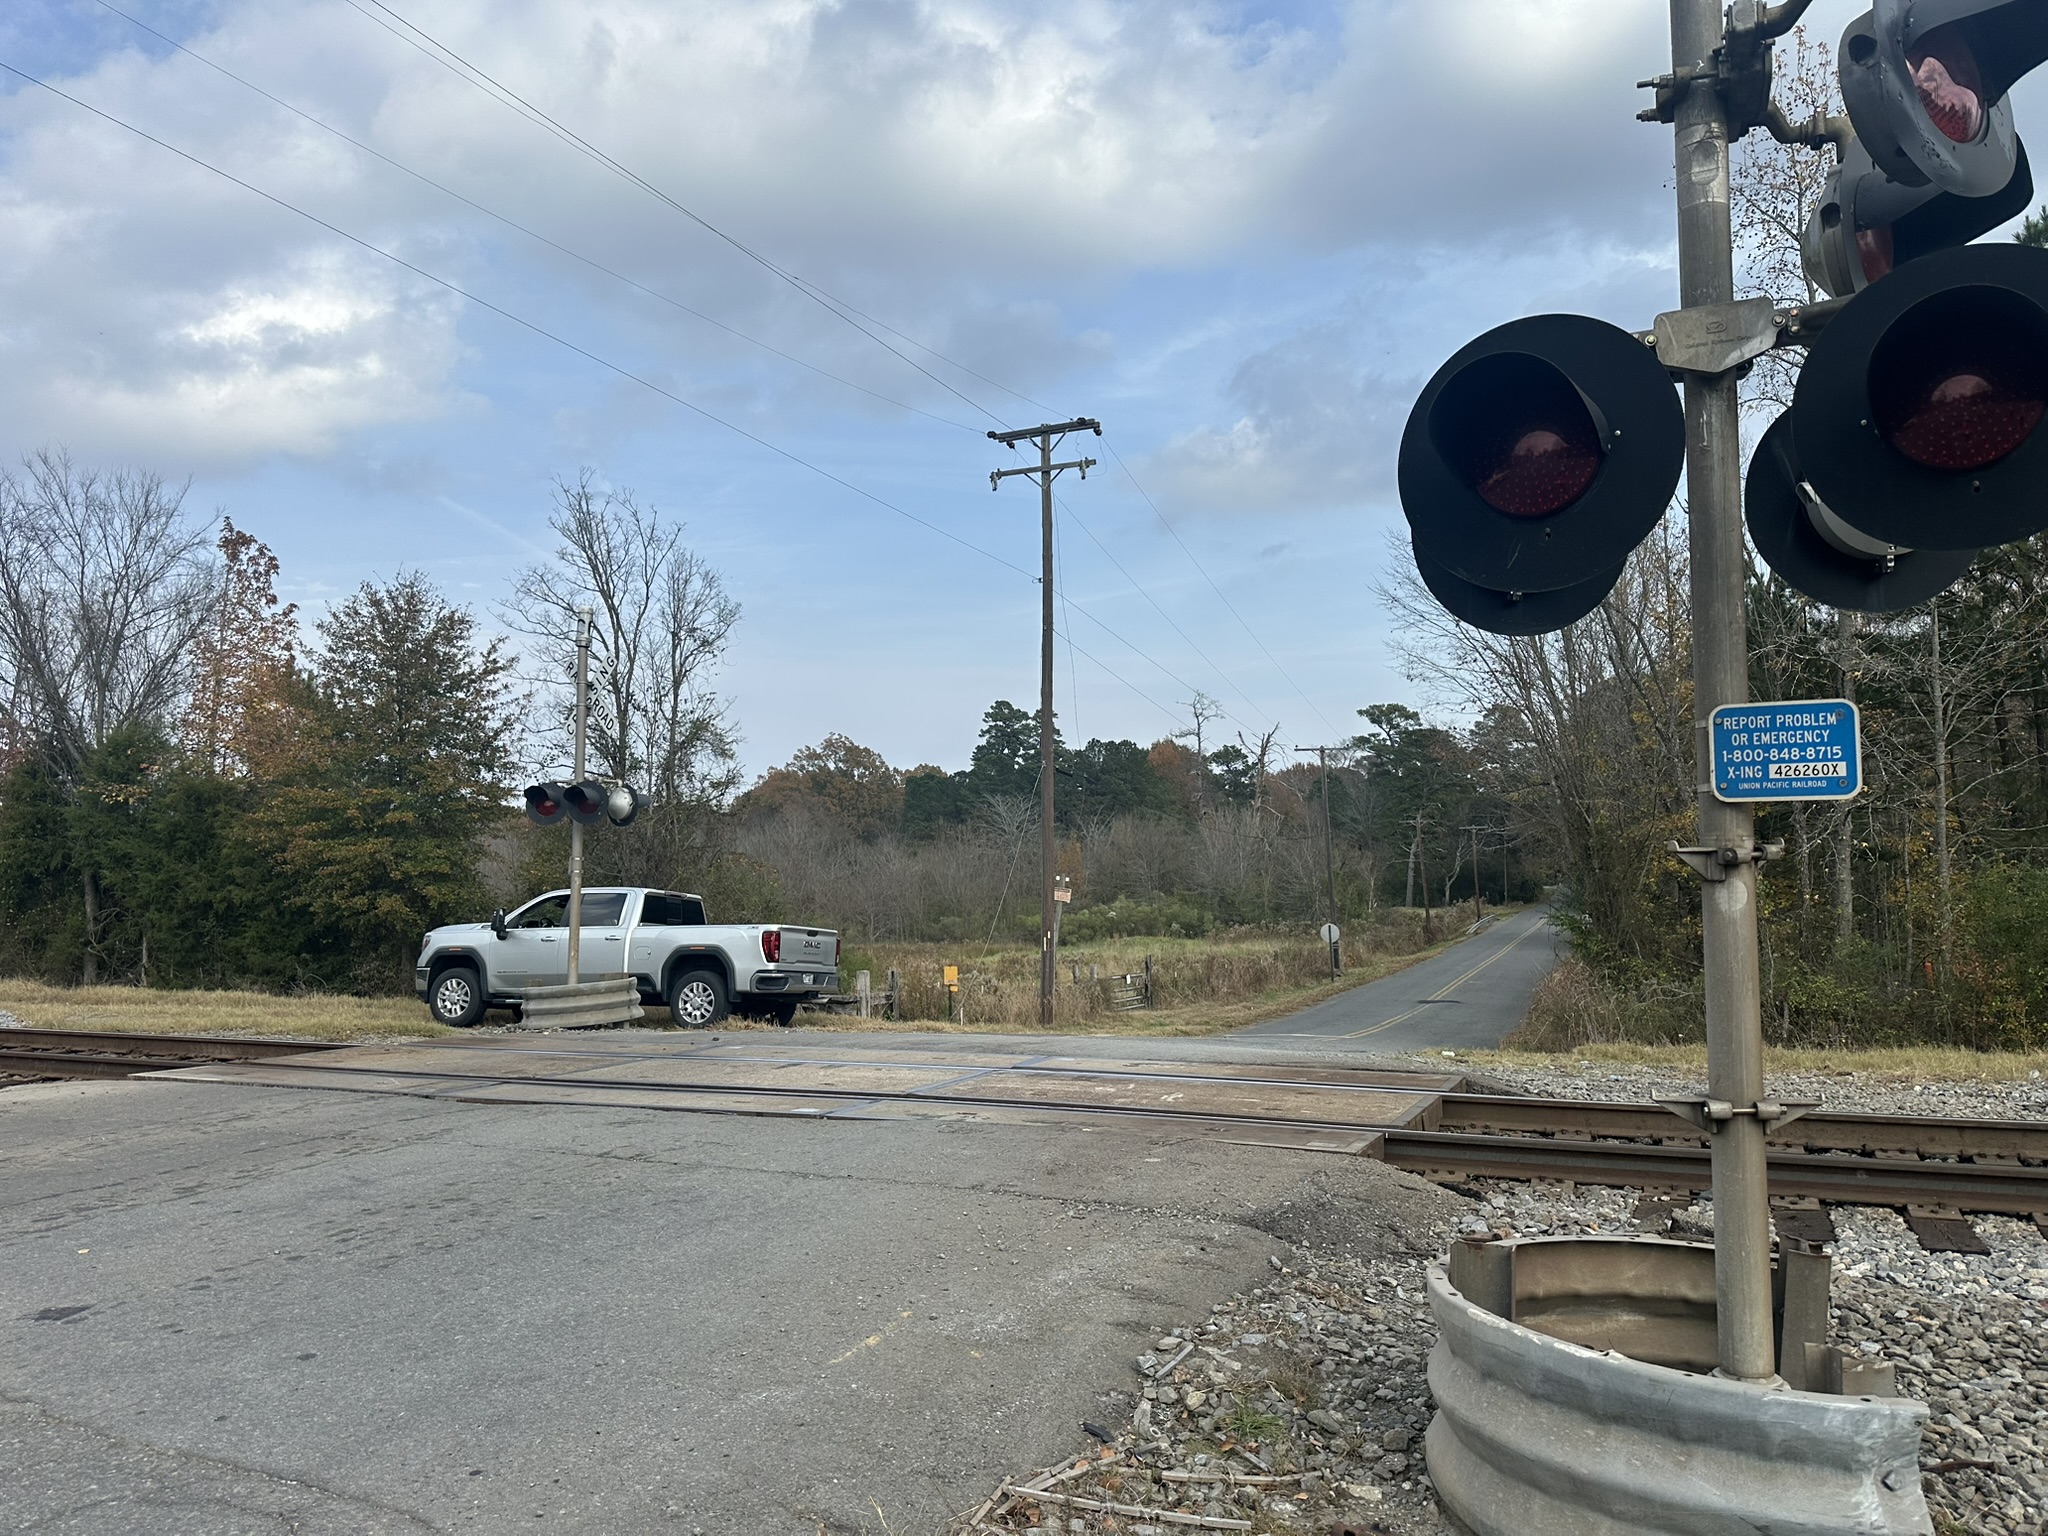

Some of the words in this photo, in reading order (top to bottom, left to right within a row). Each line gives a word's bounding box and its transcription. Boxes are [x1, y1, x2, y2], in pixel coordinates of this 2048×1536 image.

[1723, 715, 1771, 730] REPORT
[1776, 712, 1837, 727] PROBLEM
[1731, 733, 1749, 746] OR
[1753, 729, 1830, 745] EMERGENCY
[1722, 746, 1842, 763] 1-800-848-8715
[1727, 765, 1763, 779] X-ING
[1774, 763, 1839, 777] 426260X
[1738, 781, 1761, 790] UNION
[1762, 781, 1790, 789] PACIFIC
[1791, 780, 1827, 788] RAILROAD
